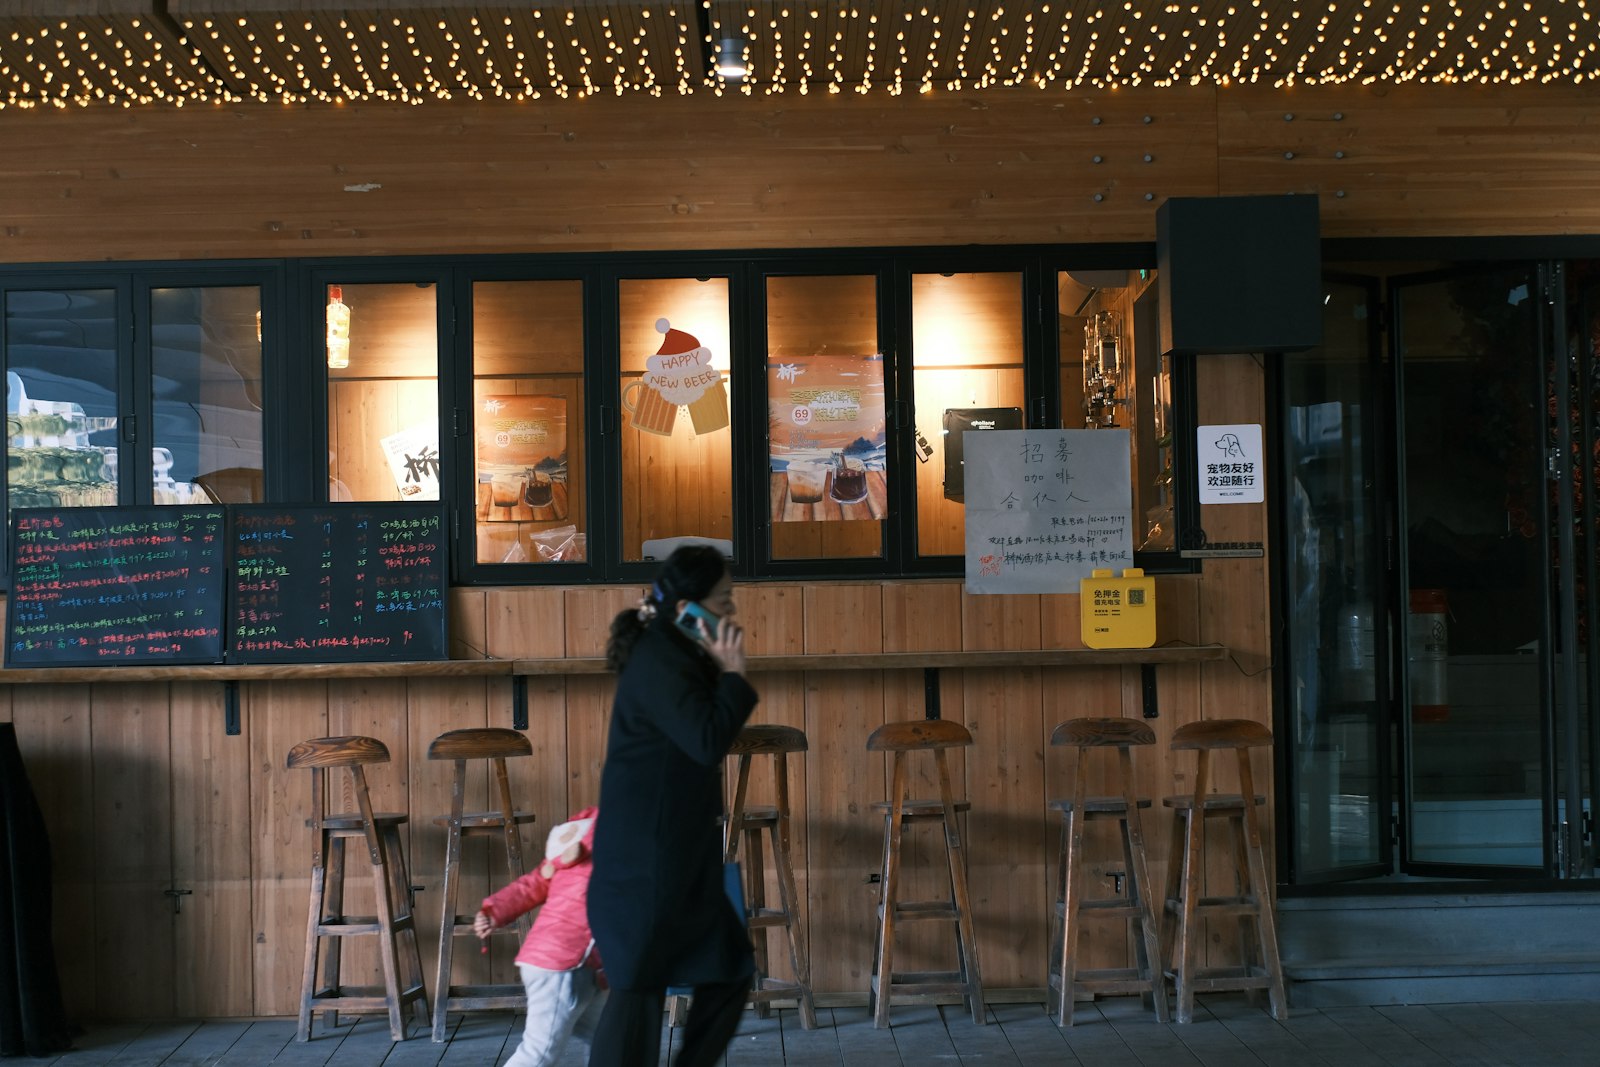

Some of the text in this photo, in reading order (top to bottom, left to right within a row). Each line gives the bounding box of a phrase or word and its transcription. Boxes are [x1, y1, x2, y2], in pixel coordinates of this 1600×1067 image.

[662, 352, 700, 369] HAPPY
[650, 370, 716, 388] NEW BEER
[795, 409, 808, 418] 69
[497, 434, 508, 442] 69
[1020, 437, 1073, 464] 招募
[1207, 463, 1254, 474] 宠物友好
[1025, 468, 1074, 484] 咖啡
[1208, 475, 1254, 486] 欢迎随行
[1000, 491, 1089, 509] 合伙人
[184, 524, 194, 533] 30
[206, 524, 217, 533] 45
[357, 521, 368, 530] 29
[203, 535, 214, 544] 45
[320, 576, 330, 586] 29
[1094, 590, 1120, 598] 免押金
[320, 603, 330, 613] 29
[174, 610, 184, 618] 45
[318, 615, 362, 627] 29 39
